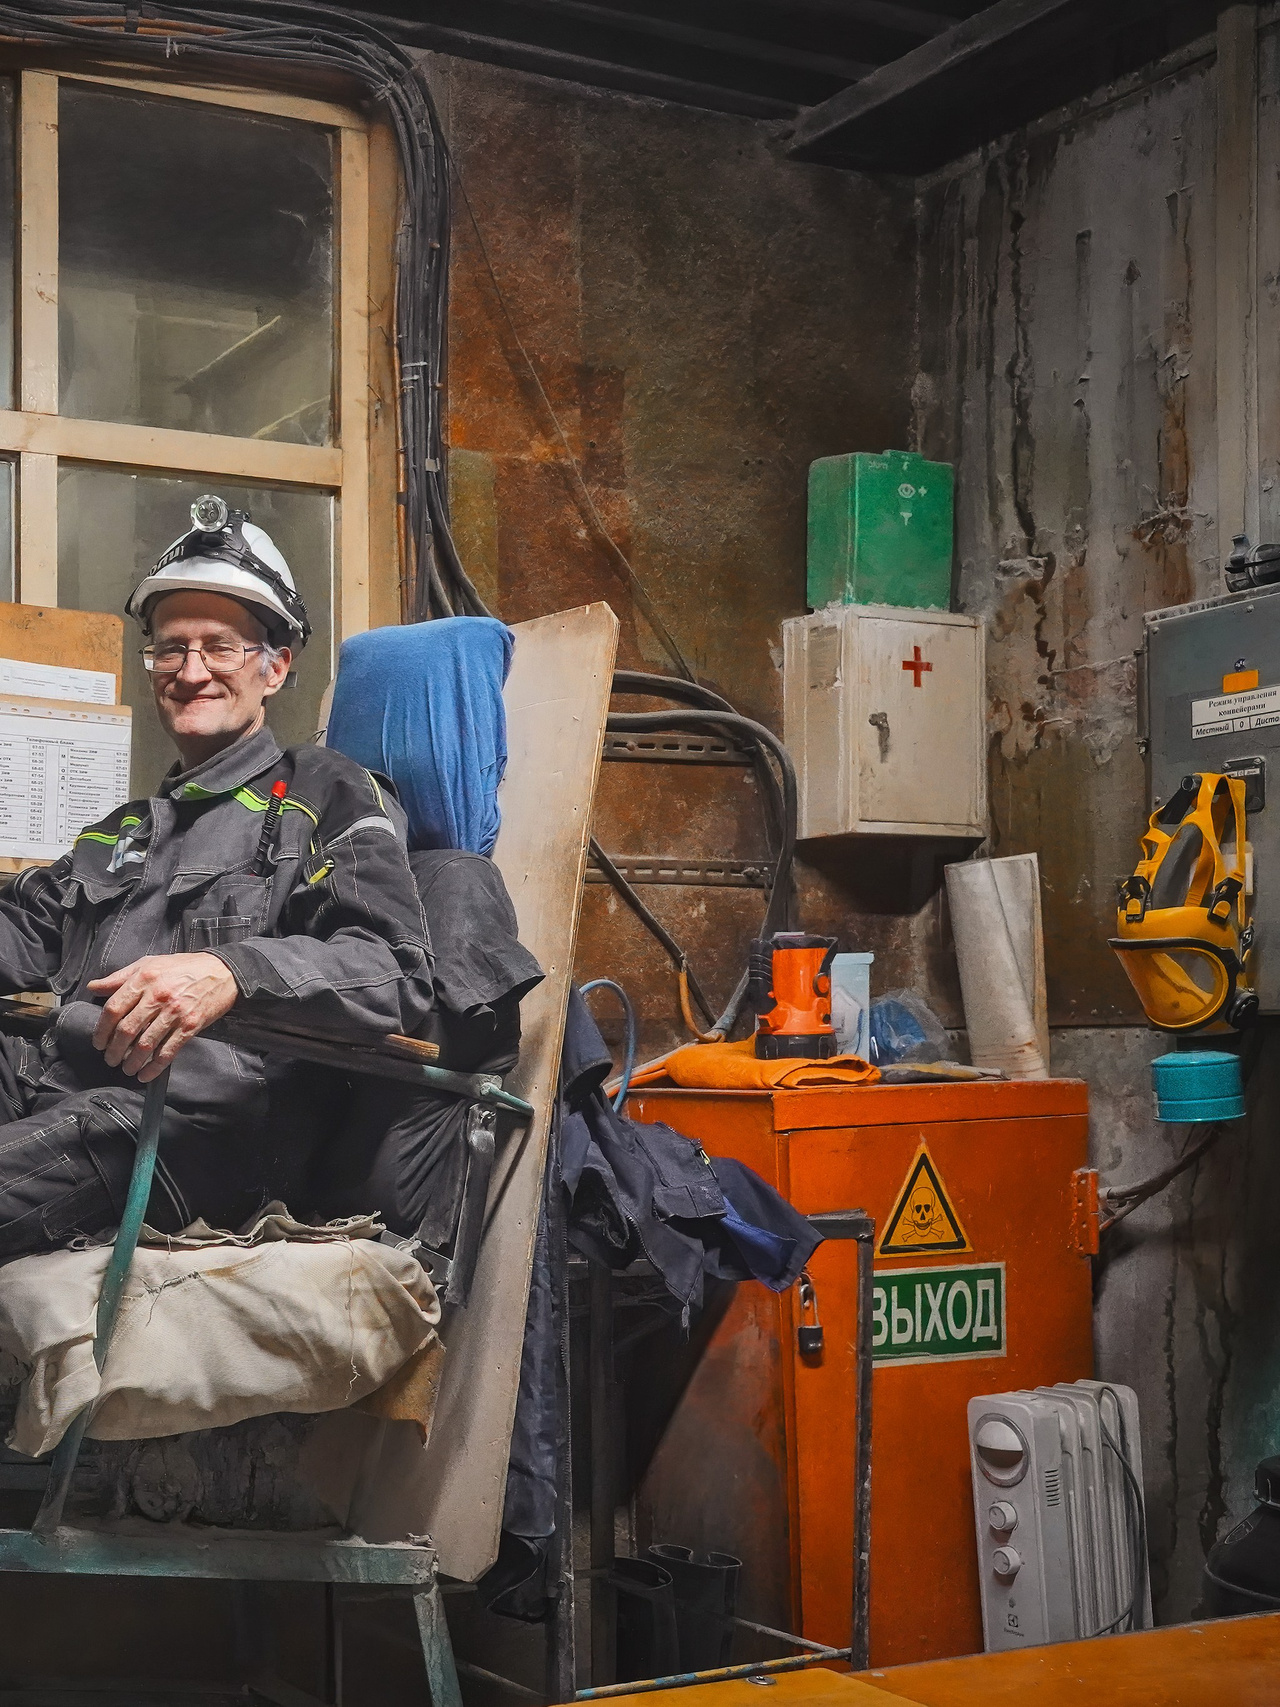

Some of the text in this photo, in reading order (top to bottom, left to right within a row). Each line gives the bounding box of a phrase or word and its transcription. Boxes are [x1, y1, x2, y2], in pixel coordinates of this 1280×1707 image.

[1208, 690, 1277, 708] Режим управления
[1218, 703, 1266, 717] конвейерами
[1195, 724, 1230, 736] Местный
[872, 1279, 997, 1347] ВЫХОД
